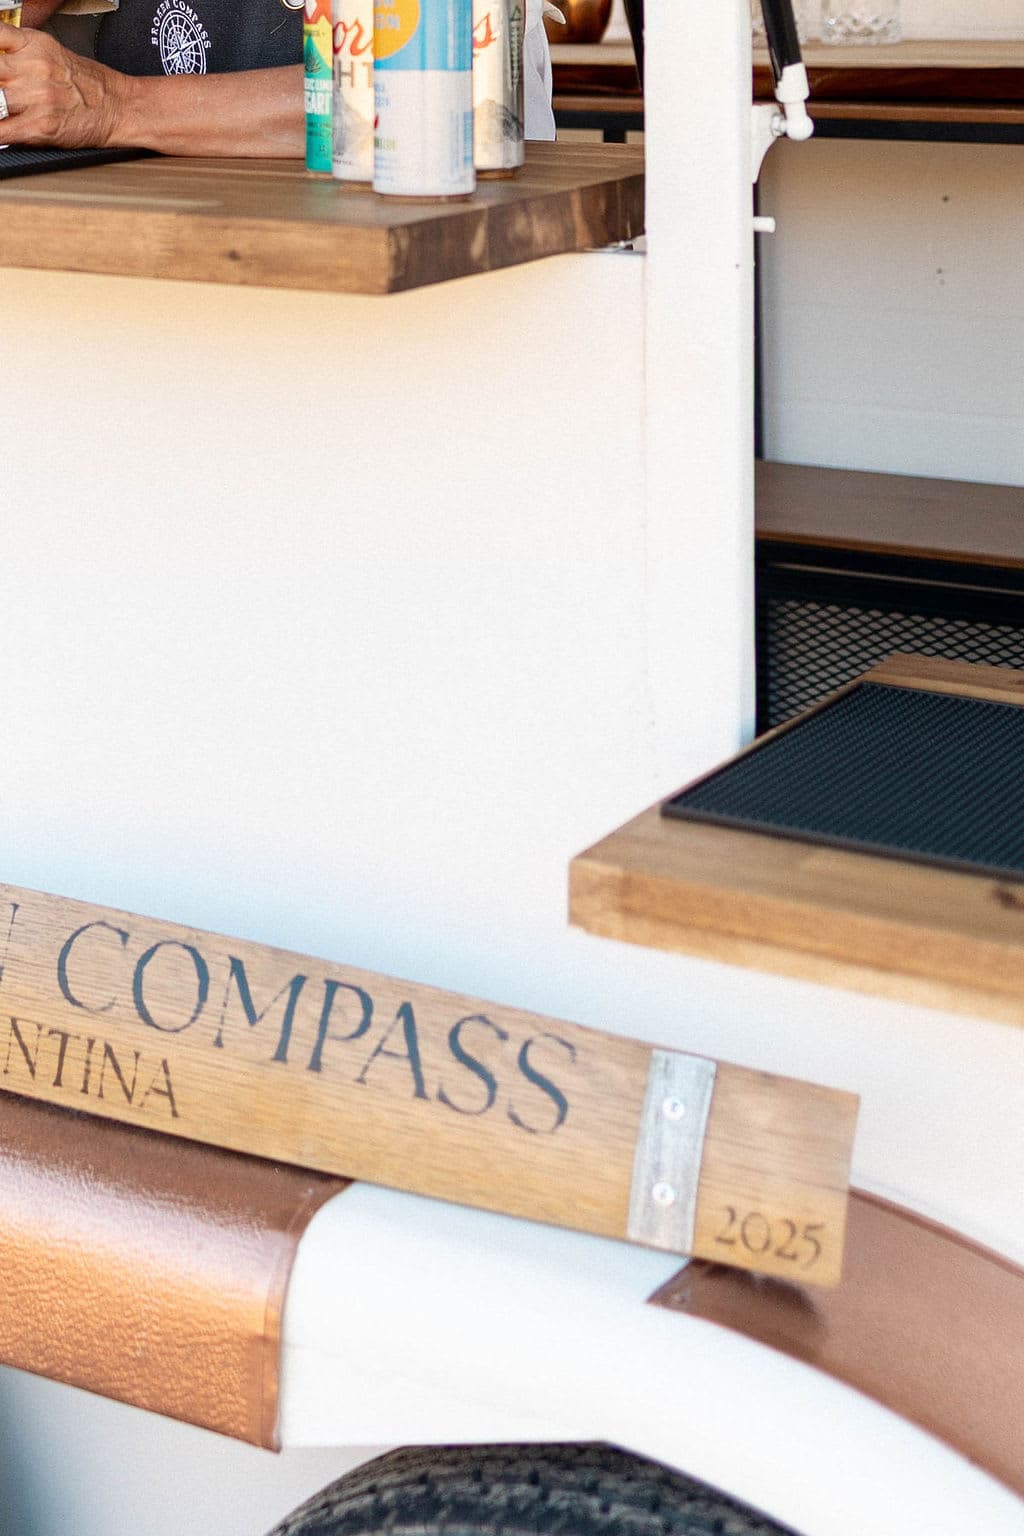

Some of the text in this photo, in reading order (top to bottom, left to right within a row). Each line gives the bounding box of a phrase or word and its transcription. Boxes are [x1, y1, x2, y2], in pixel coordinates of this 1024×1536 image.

[151, 0, 171, 46] BROKEN
[57, 920, 578, 1135] COMPASS
[713, 1205, 826, 1271] 2025
